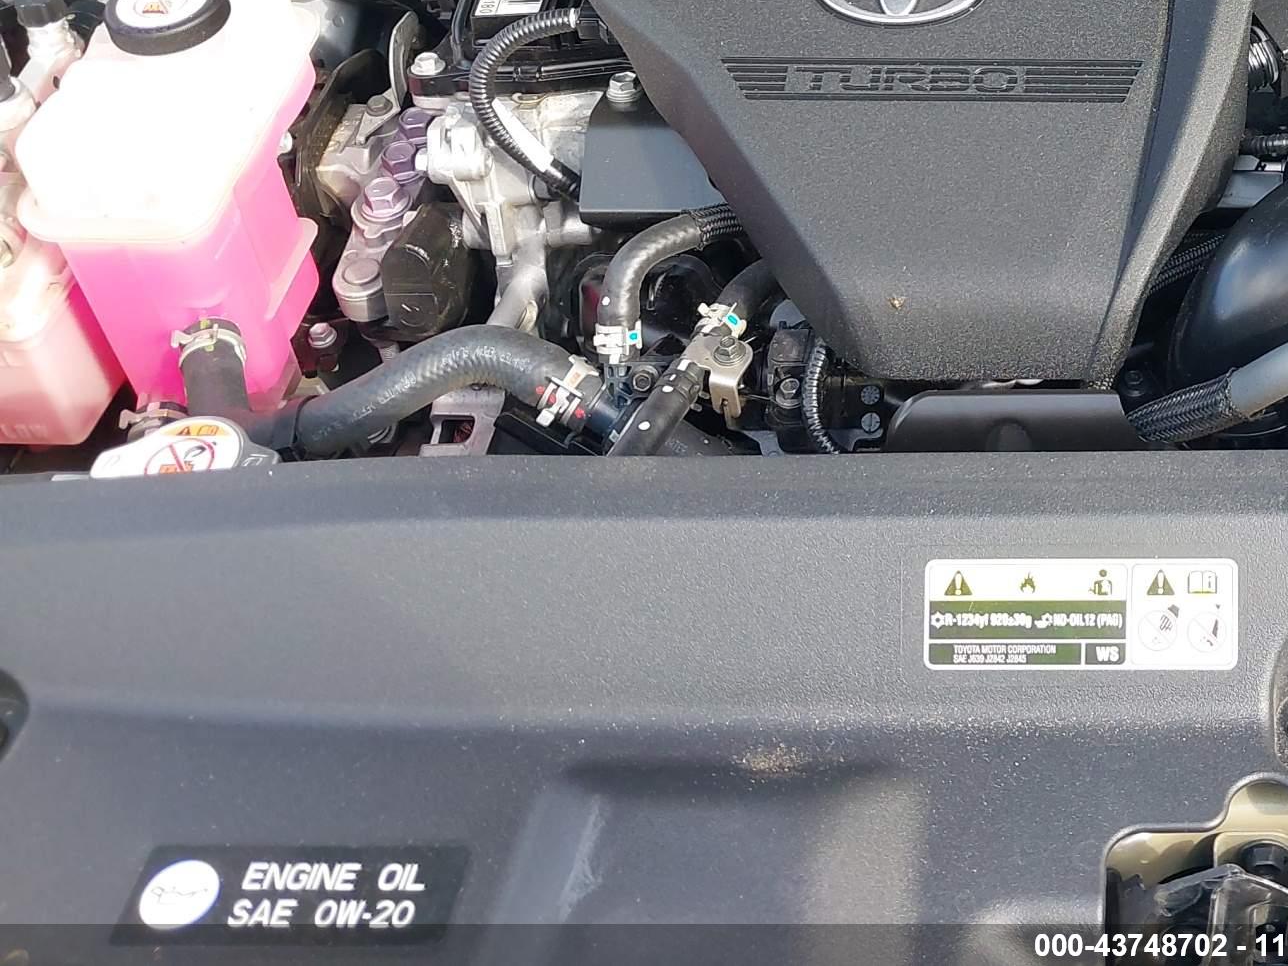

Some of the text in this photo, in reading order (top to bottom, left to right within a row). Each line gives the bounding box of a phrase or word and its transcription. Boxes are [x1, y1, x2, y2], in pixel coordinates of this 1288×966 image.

[793, 66, 1019, 93] TURBO
[953, 644, 1057, 654] TOYOTA MOTOR CORPORATION
[953, 654, 967, 664] SAE
[1095, 646, 1120, 662] WS
[241, 861, 426, 892] ENGINE OIL
[227, 898, 417, 929] SAE 0W-20
